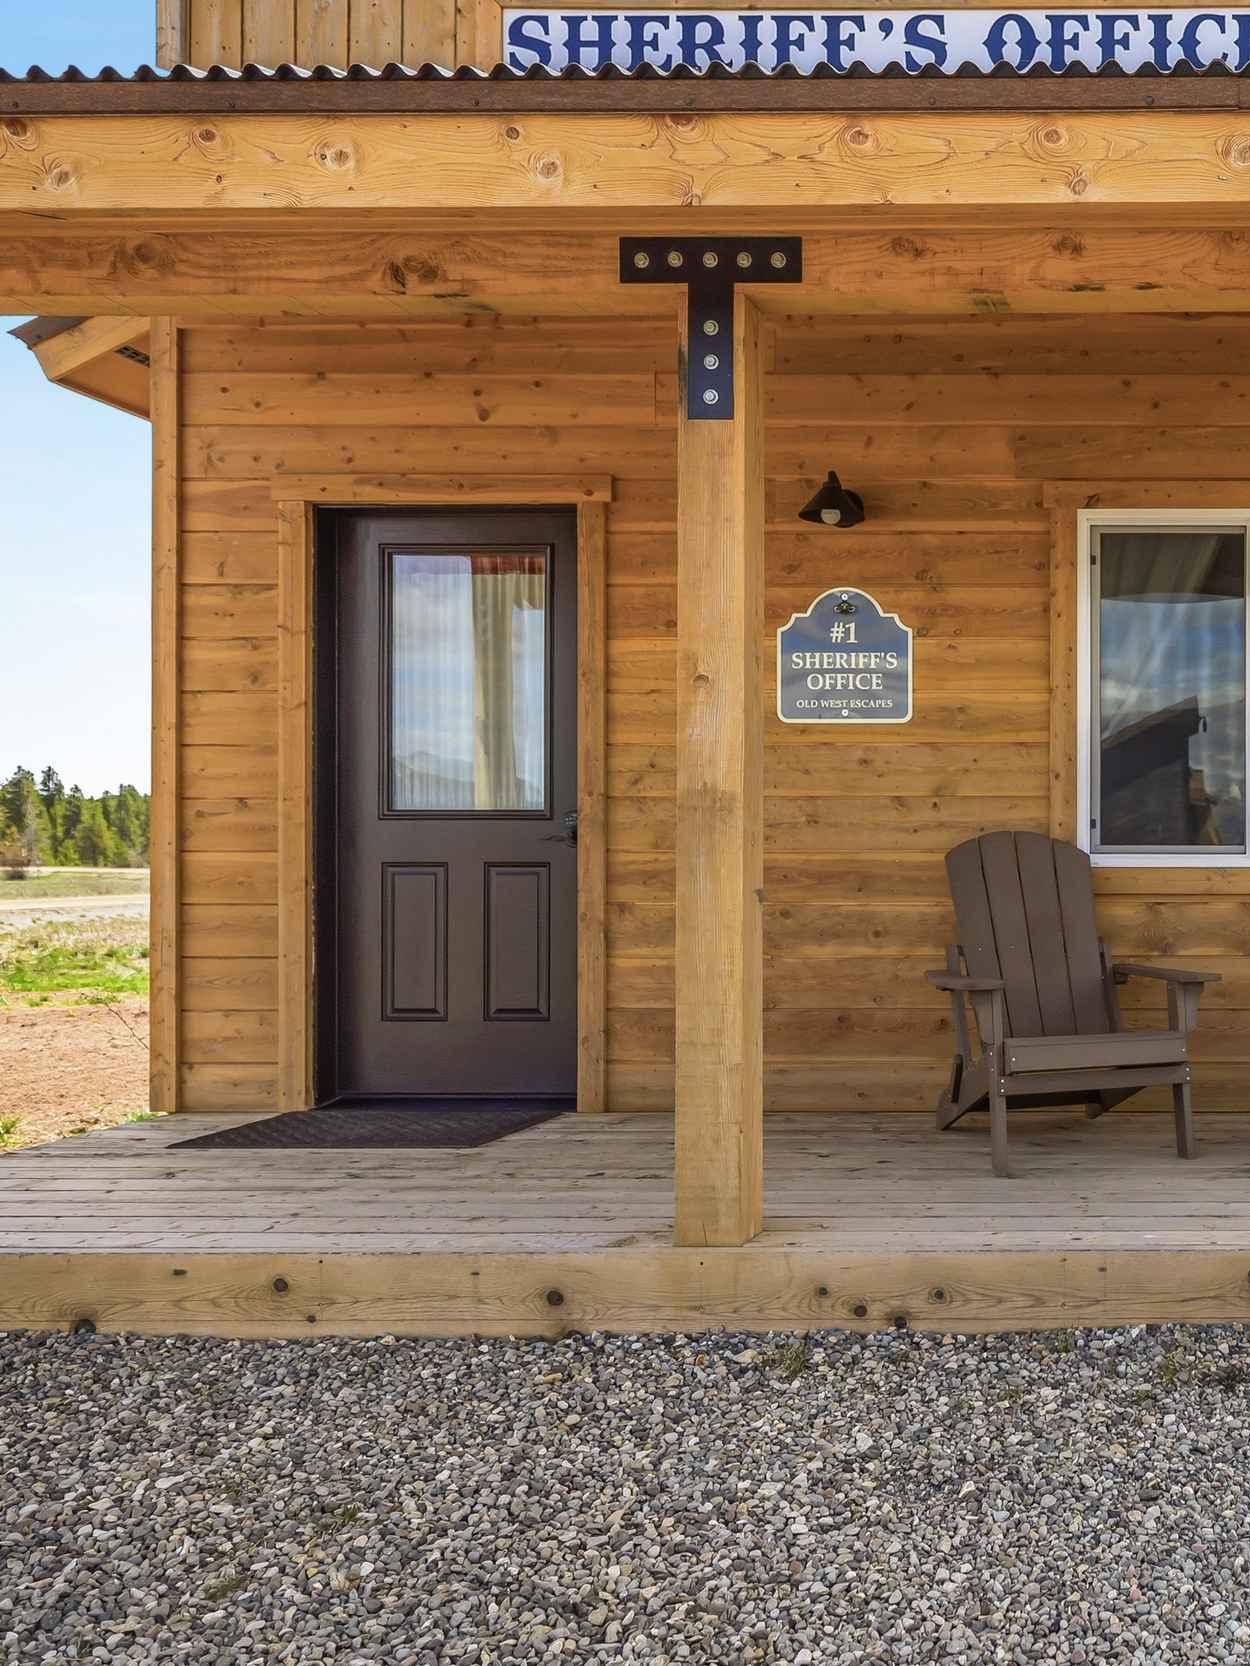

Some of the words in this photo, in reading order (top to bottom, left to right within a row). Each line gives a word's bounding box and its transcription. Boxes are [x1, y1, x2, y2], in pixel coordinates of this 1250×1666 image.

[507, 14, 948, 73] SHERIFF'S
[830, 622, 858, 643] #1
[791, 652, 898, 669] SHERIFF'S
[806, 673, 883, 690] OFFICE
[796, 700, 818, 708] OLD
[821, 700, 847, 708] WEST
[849, 700, 893, 708] ESCAPES
